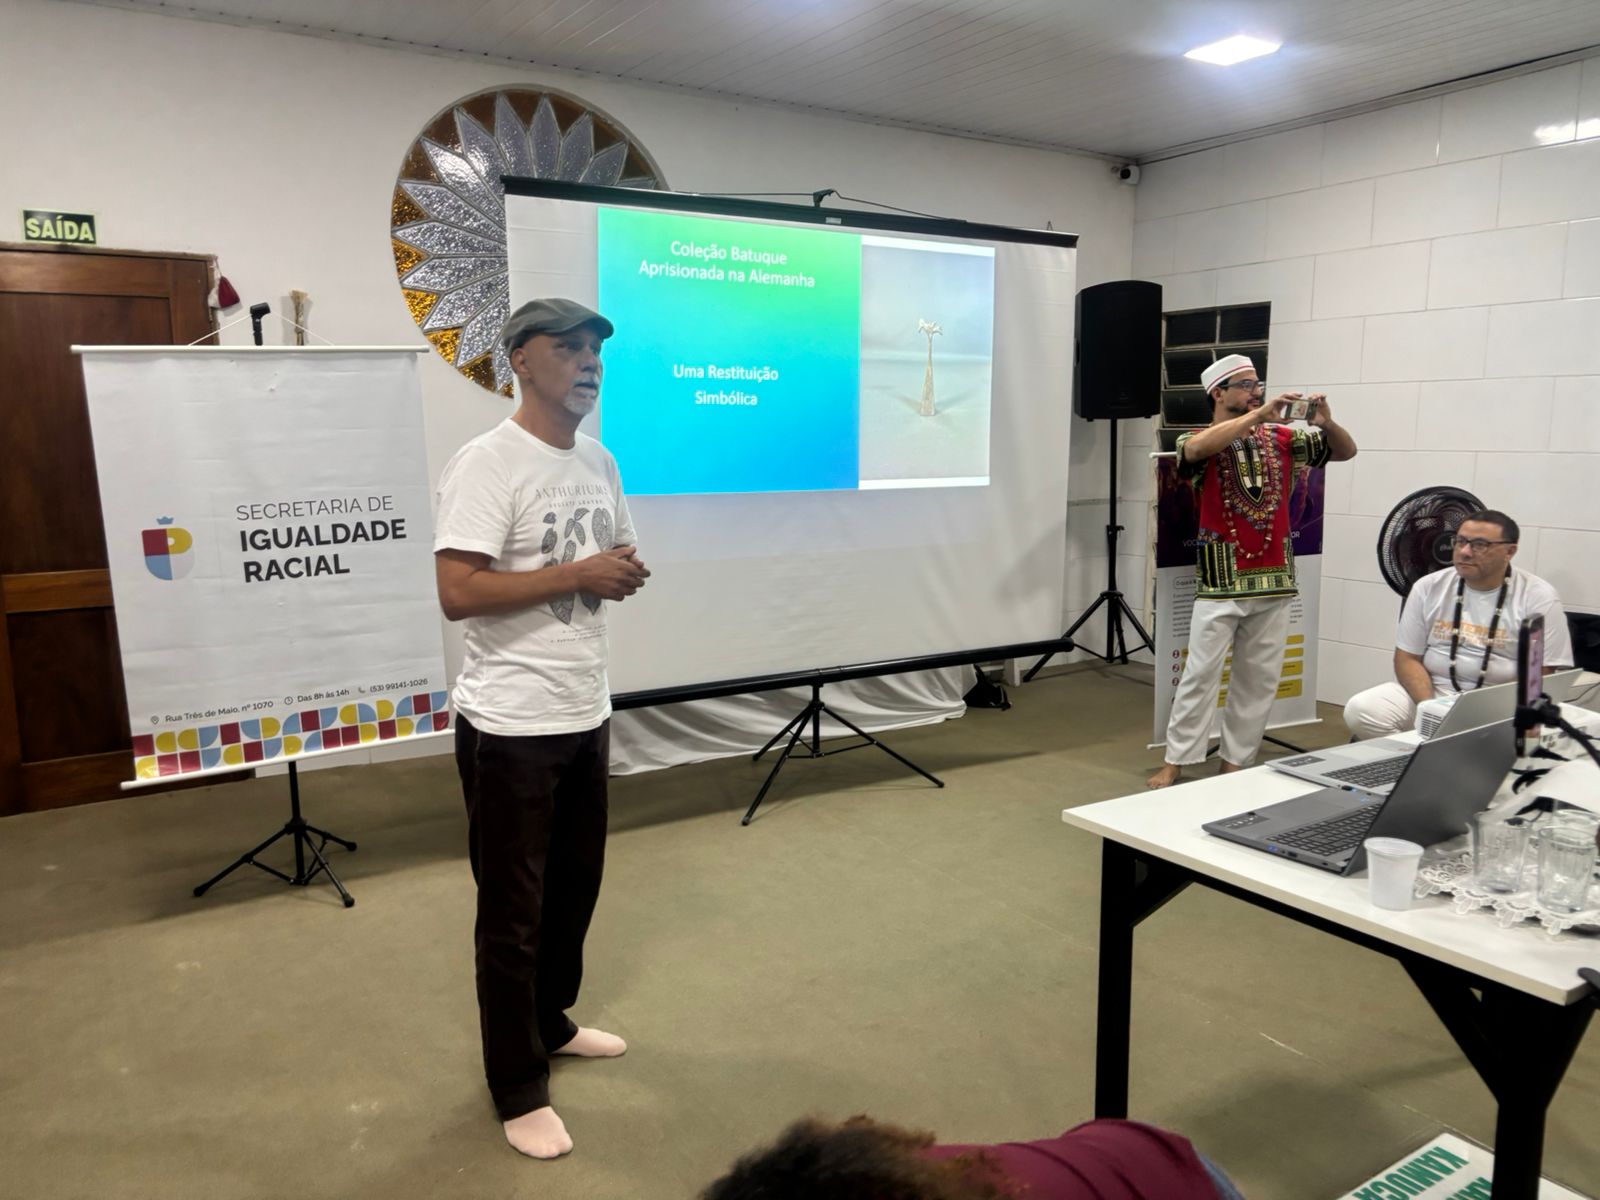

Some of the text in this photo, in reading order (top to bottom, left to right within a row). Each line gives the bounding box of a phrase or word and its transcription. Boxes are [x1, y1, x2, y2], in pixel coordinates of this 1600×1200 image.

[26, 215, 95, 242] SAÍDA
[671, 241, 787, 266] Coleção Batuque
[638, 260, 815, 288] Aprisionada na Alemanha
[673, 364, 779, 383] Uma Restituição
[695, 390, 758, 406] Simbólica
[236, 495, 394, 521] SECRETARIA DE
[240, 518, 407, 552] IGUALDADE
[243, 553, 350, 583] RACIAL
[297, 694, 313, 703] Das
[313, 692, 325, 701] 8h
[336, 688, 350, 697] 14h
[370, 678, 429, 693] (53) 99141-1026
[165, 714, 183, 723] Rua
[184, 711, 203, 720] Três
[205, 710, 216, 718] de
[253, 700, 274, 711] 1070
